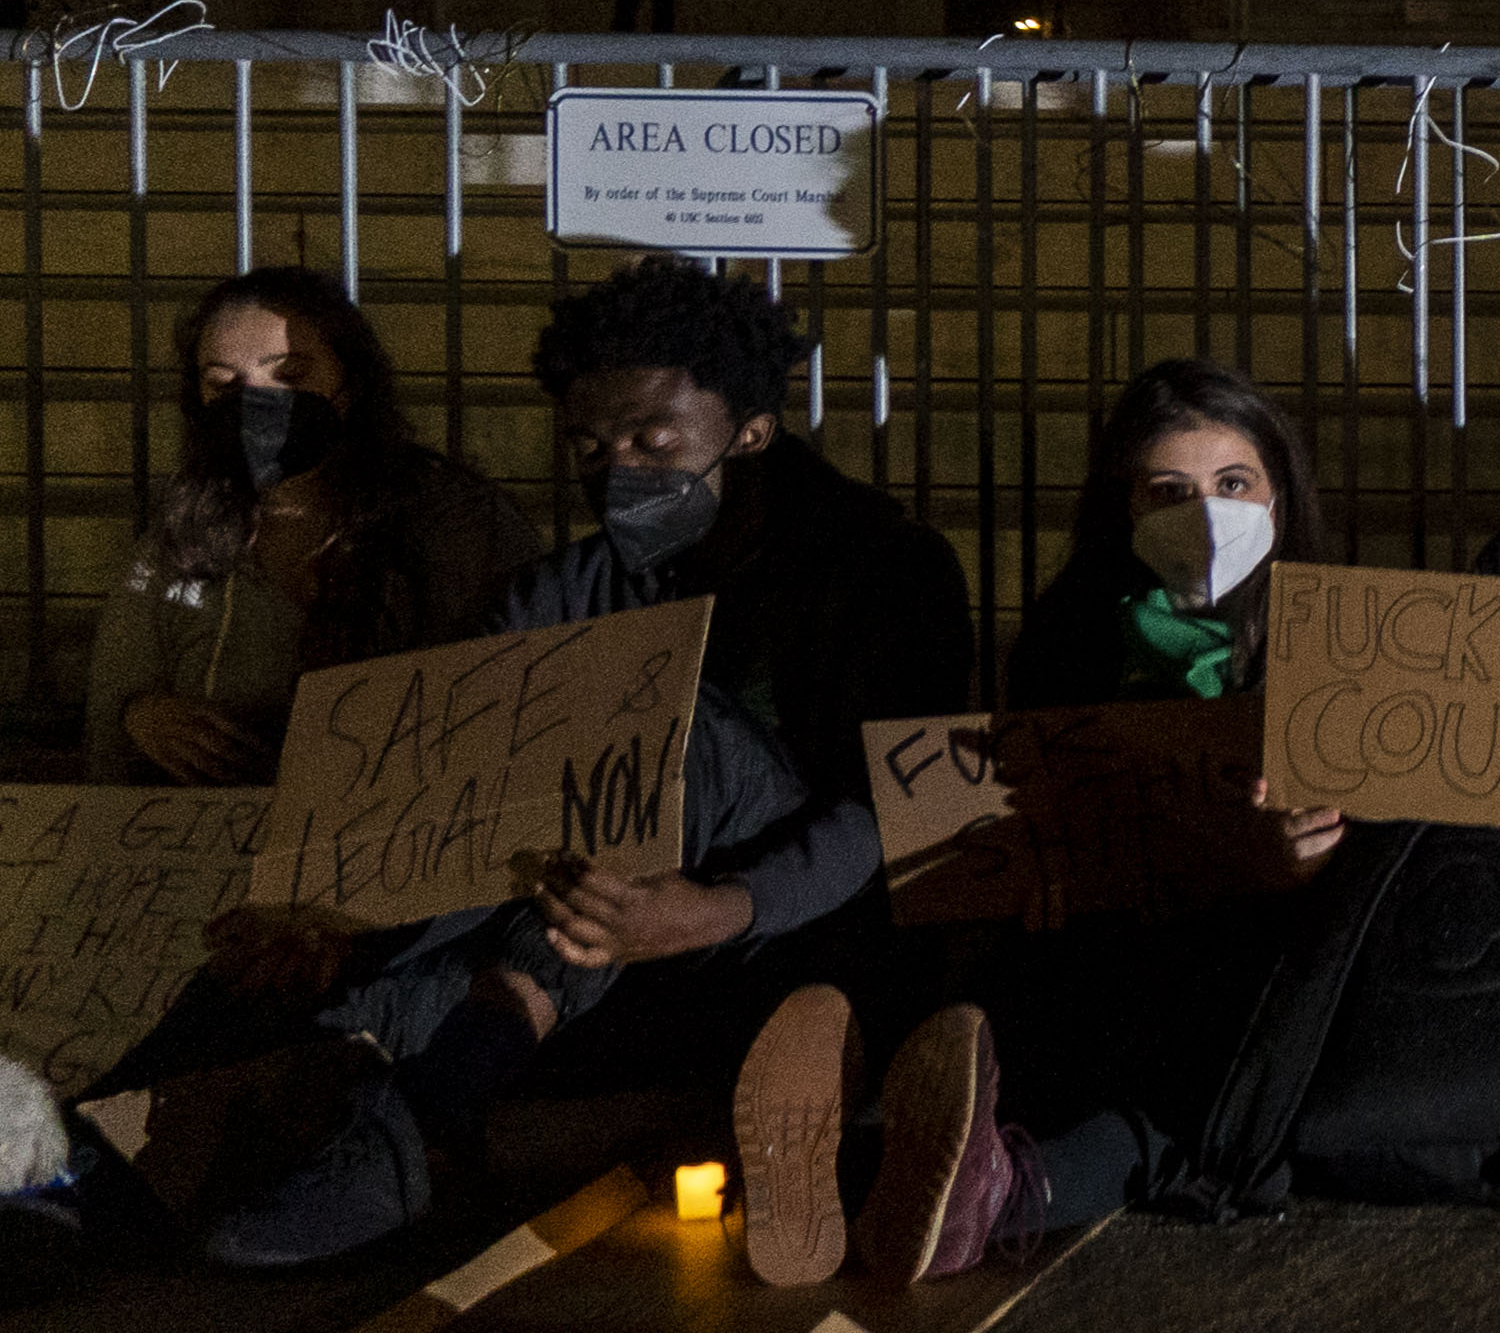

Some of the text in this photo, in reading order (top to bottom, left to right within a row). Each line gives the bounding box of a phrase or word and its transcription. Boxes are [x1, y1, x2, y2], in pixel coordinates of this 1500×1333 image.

[588, 121, 843, 155] AREA CLOSED
[584, 186, 601, 203] By
[606, 187, 640, 201] order
[645, 187, 661, 201] of
[665, 187, 686, 202] the
[691, 188, 747, 205] Supreme
[751, 188, 789, 204] Court
[328, 626, 673, 801] SAFE &
[29, 801, 81, 855] A
[117, 796, 273, 856] GIRL
[290, 716, 679, 911] LEGAL NOW
